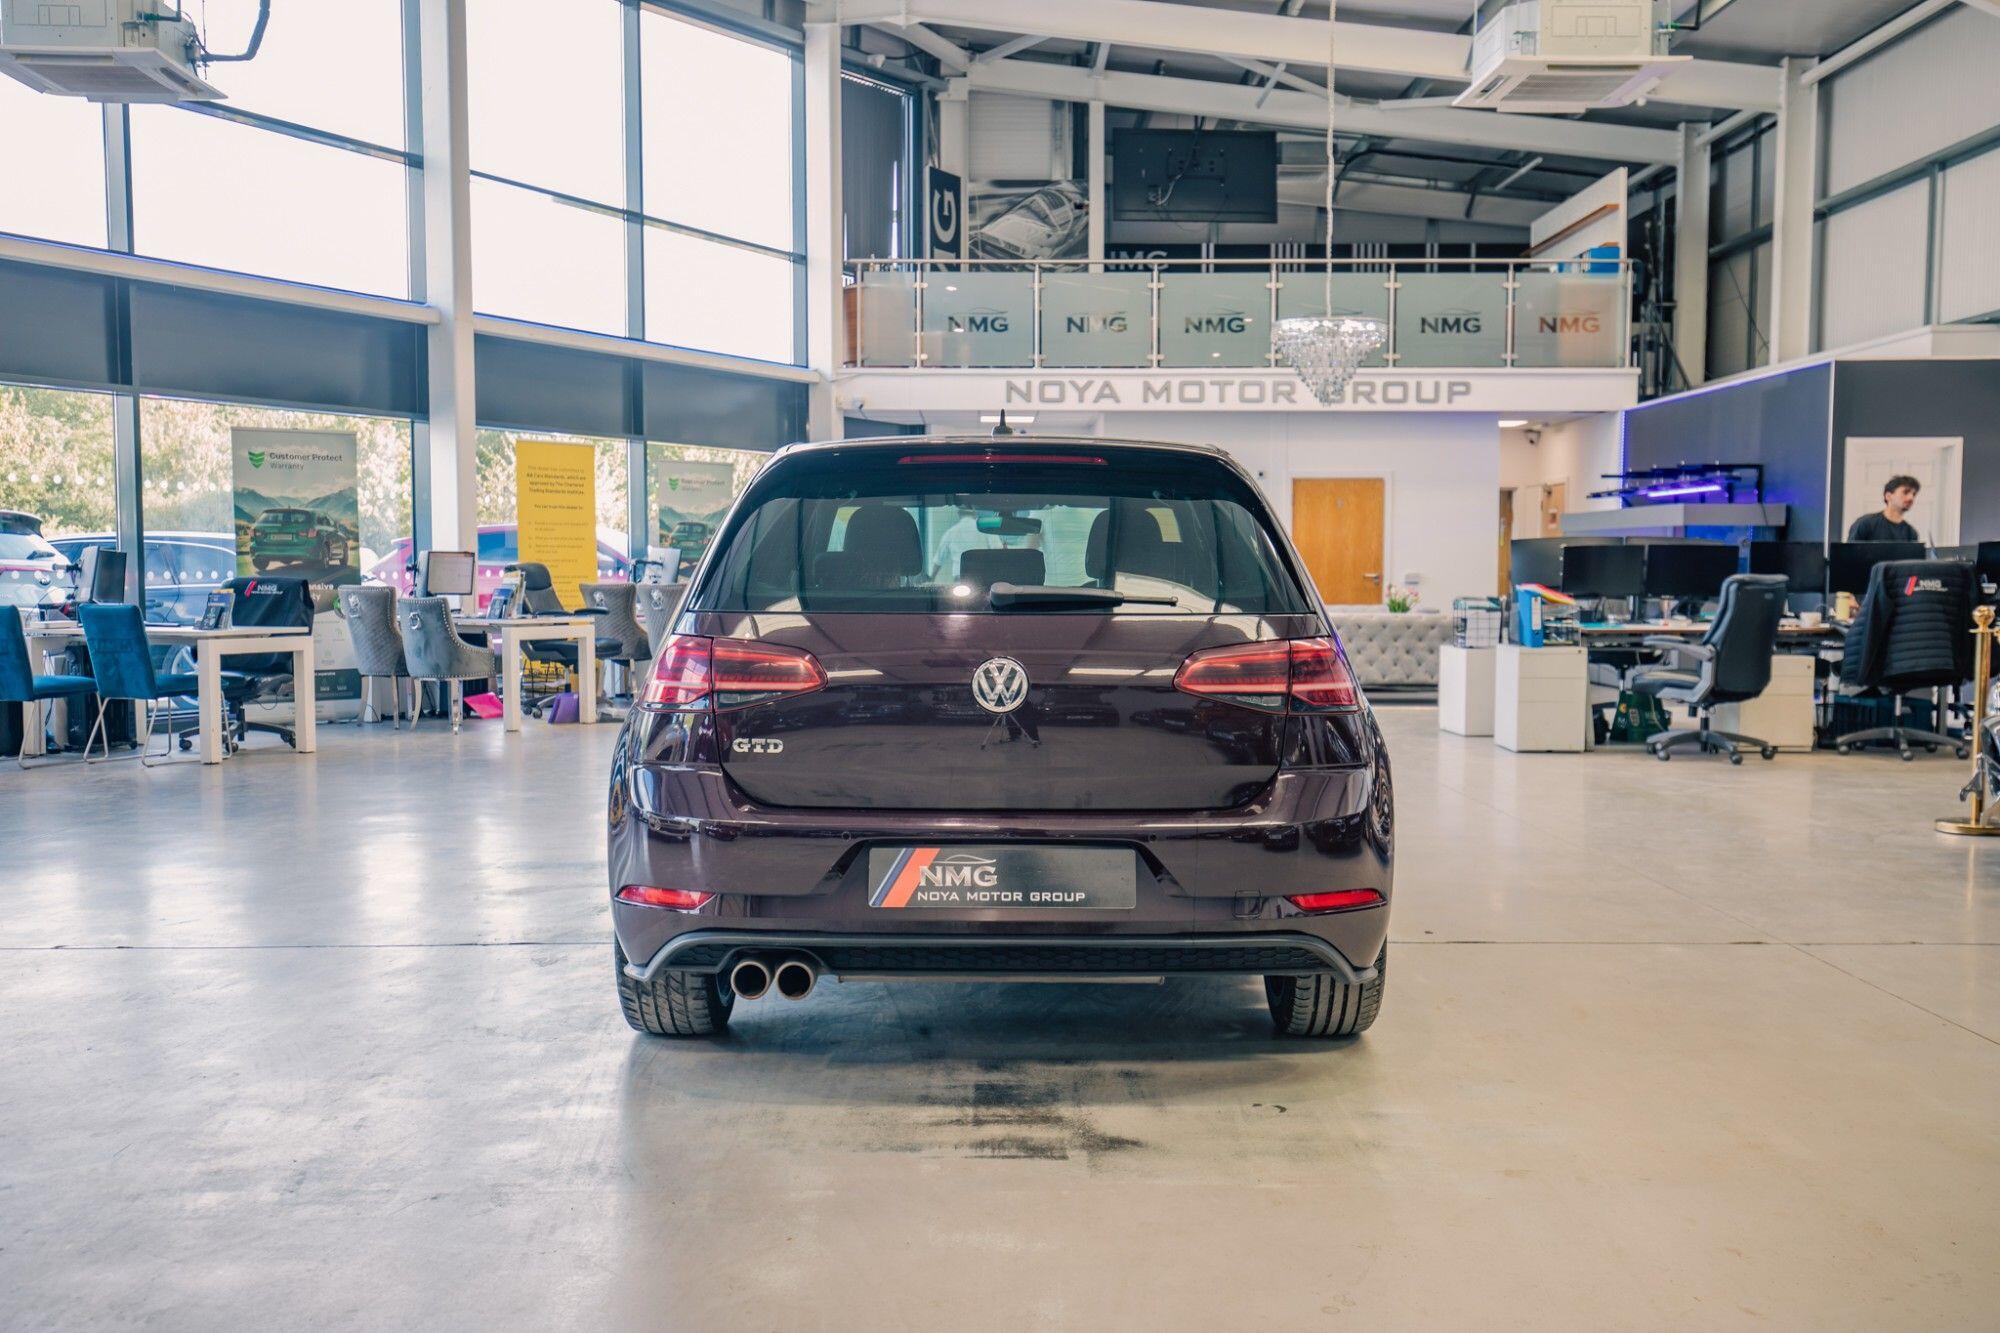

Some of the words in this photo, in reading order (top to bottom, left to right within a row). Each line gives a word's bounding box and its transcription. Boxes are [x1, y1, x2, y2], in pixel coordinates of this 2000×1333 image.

[948, 316, 1008, 333] NMG
[1185, 316, 1246, 333] NMG
[1420, 316, 1481, 334] NMG
[1539, 316, 1600, 334] NMG
[1006, 379, 1120, 403] NOYA
[1143, 379, 1297, 404] MOTOR
[269, 452, 309, 461] Customer
[312, 453, 343, 462] Protect
[270, 463, 304, 471] Warranty
[257, 584, 277, 592] NMG
[732, 738, 784, 754] GTD
[918, 865, 998, 887] NMG
[917, 891, 960, 902] NOYA
[966, 891, 1023, 902] MOTOR
[1030, 891, 1086, 902] GROUP
